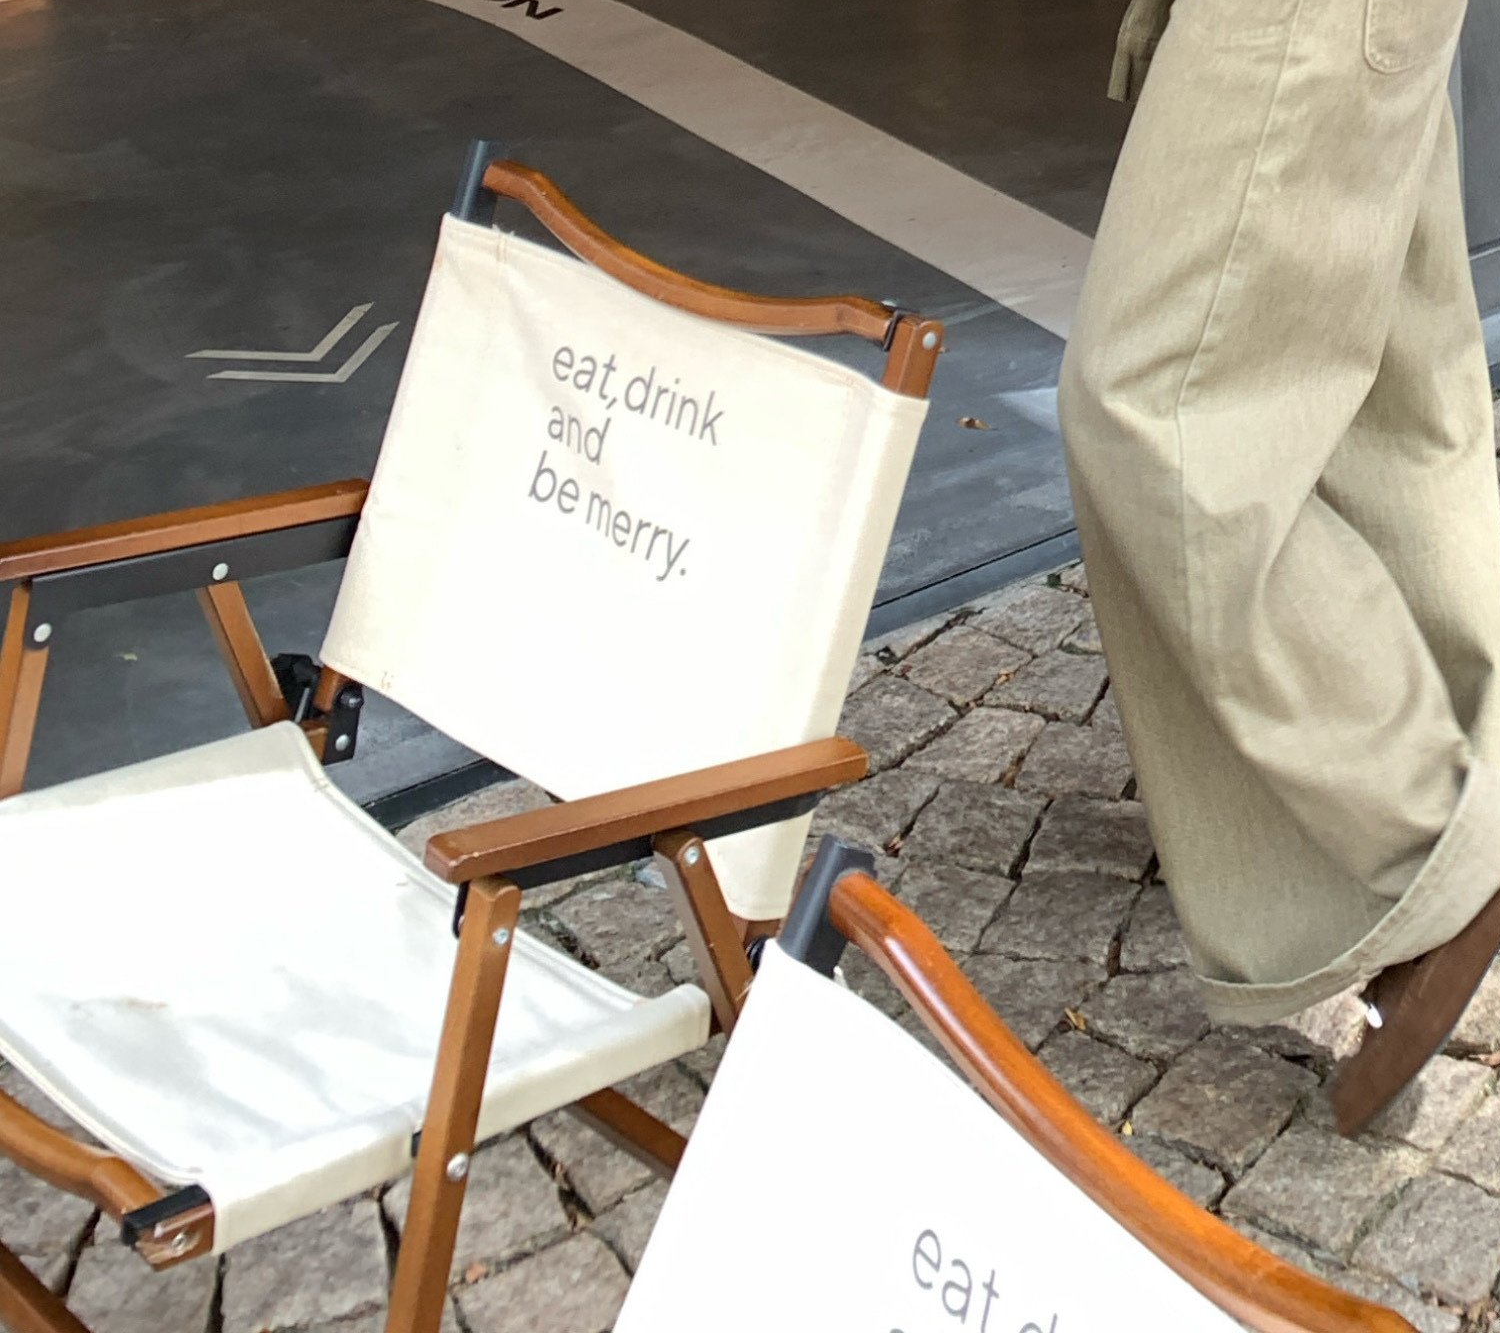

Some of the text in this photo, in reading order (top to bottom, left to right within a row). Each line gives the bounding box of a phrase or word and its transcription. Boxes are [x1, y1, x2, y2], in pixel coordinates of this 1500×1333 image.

[547, 405, 612, 466] and
[624, 365, 725, 447] drink
[527, 449, 691, 582] be merry.
